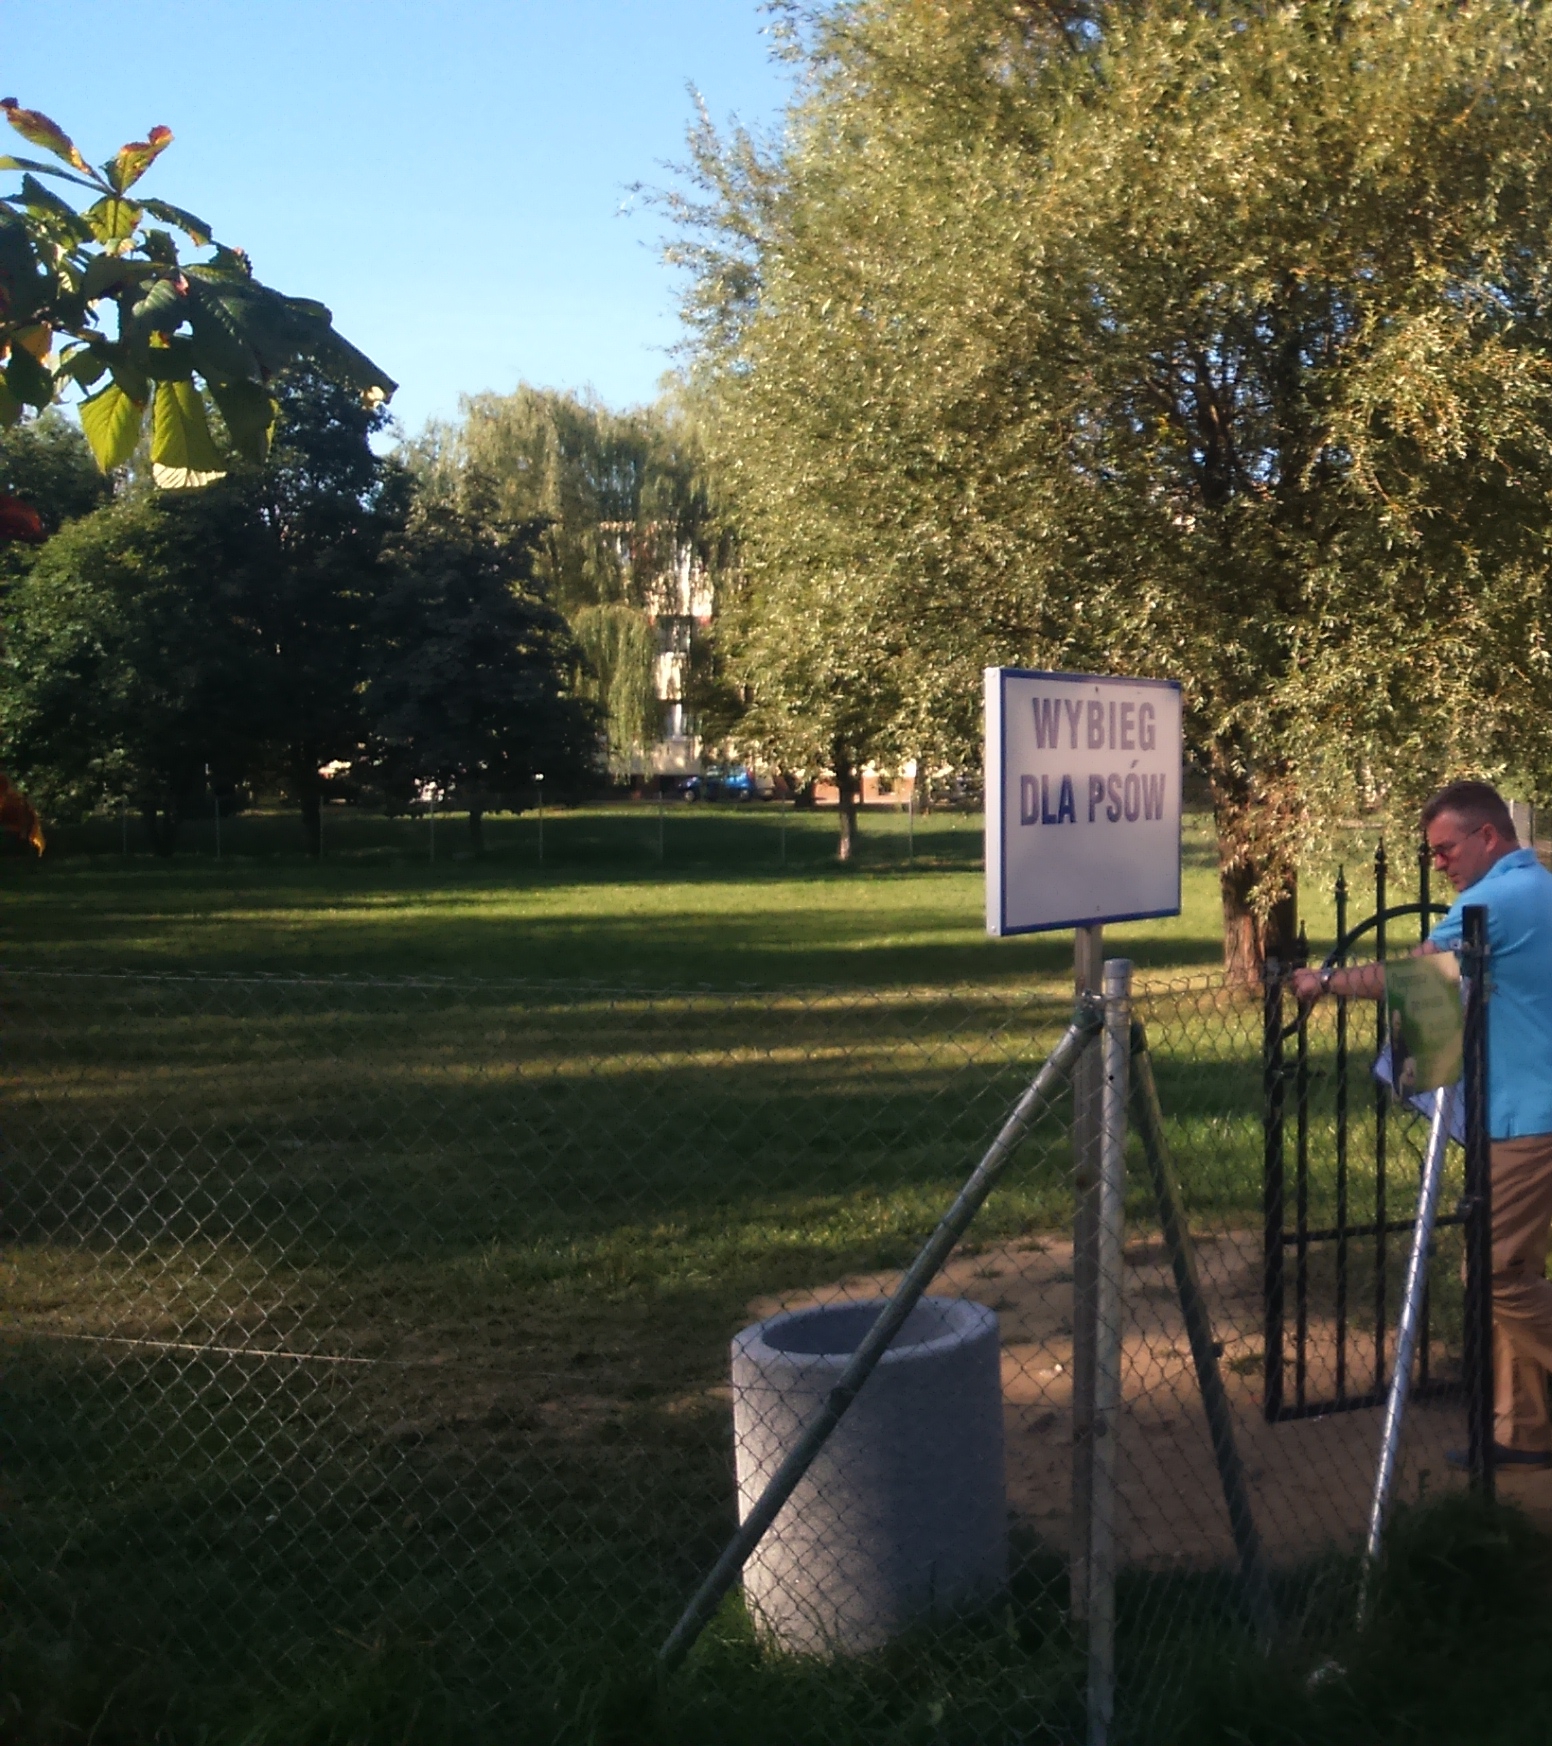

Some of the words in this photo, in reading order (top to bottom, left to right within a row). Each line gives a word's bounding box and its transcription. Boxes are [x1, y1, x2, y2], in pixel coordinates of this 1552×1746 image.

[1032, 697, 1156, 750] WYBIEG
[1020, 774, 1076, 826] DLA
[1088, 759, 1166, 823] PSÓW
